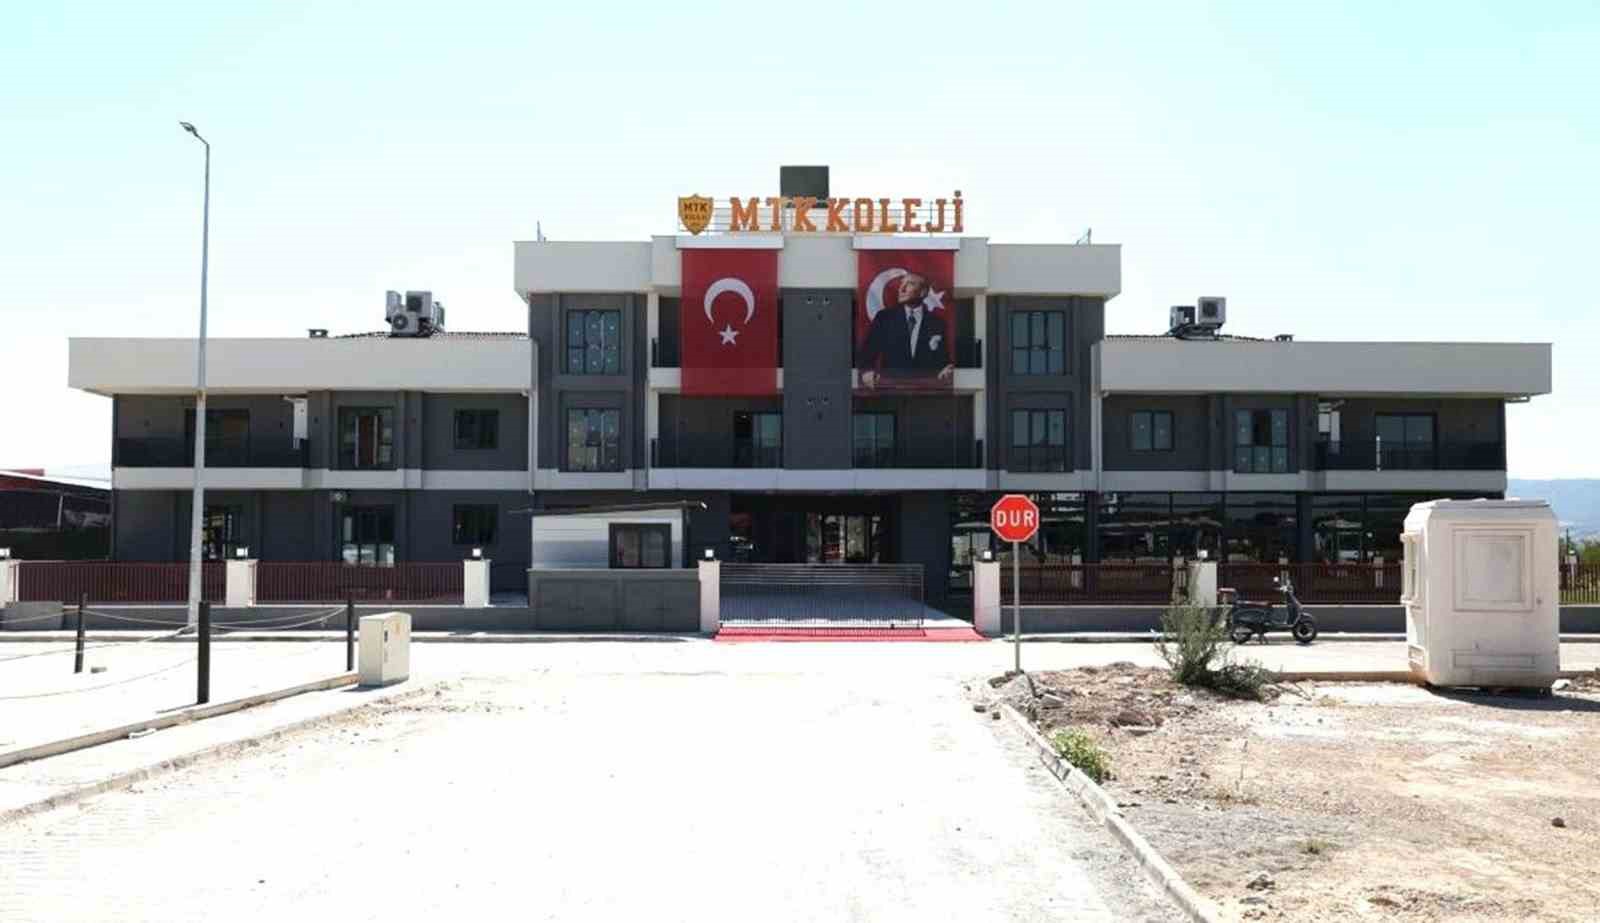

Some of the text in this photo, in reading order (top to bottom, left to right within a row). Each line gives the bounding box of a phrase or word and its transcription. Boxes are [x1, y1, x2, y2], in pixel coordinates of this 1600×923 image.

[683, 202, 708, 212] MTK
[730, 190, 963, 232] MTK KOLEJİ
[996, 509, 1035, 528] DUR
